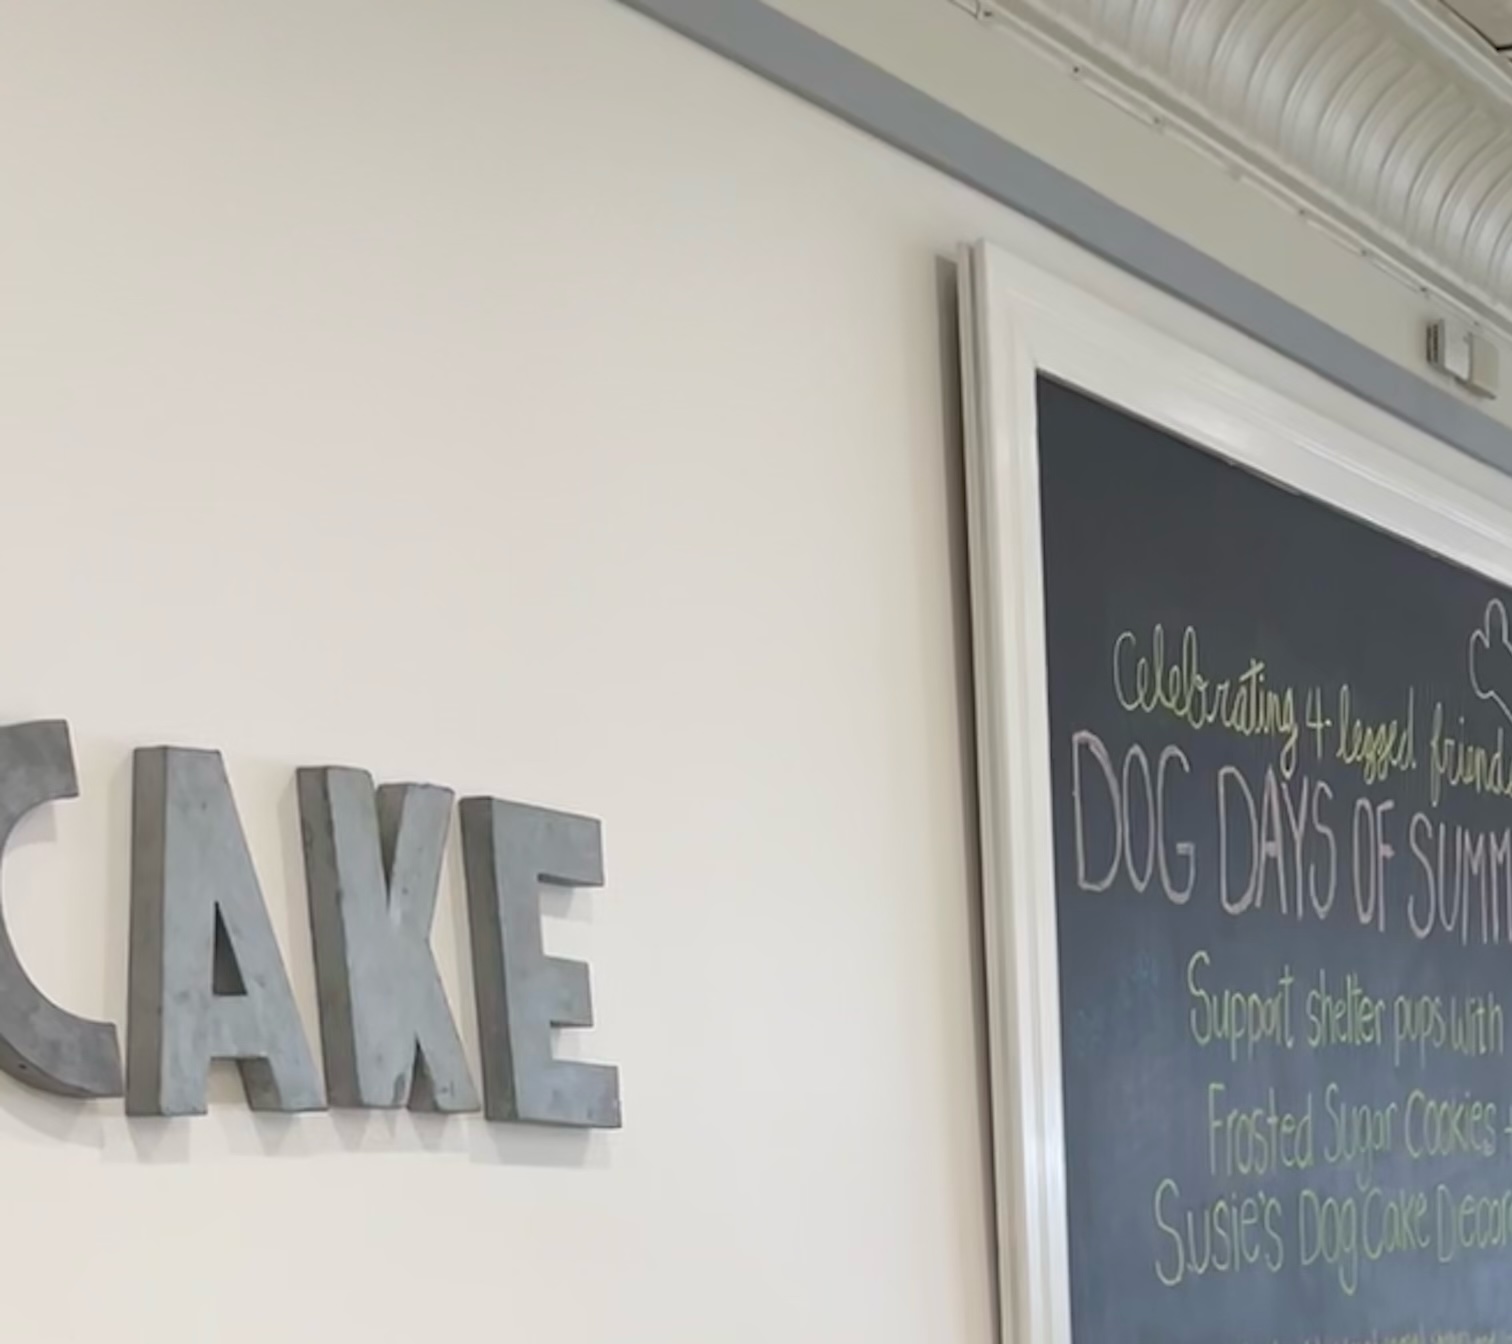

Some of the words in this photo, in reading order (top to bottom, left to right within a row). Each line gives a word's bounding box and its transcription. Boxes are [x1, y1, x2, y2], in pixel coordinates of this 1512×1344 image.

[1114, 622, 1299, 780] Celebrating
[1072, 730, 1196, 904] DOG
[1218, 765, 1337, 920] DAYS
[1353, 798, 1395, 932] OF
[0, 719, 622, 1128] CAKE
[1187, 950, 1294, 1062] Support
[1306, 968, 1385, 1047] shelter
[1394, 995, 1446, 1070] pups
[1452, 992, 1504, 1056] with
[1208, 1082, 1313, 1176] Frosted
[1324, 1082, 1397, 1192] Sugar
[1404, 1089, 1497, 1157] Cookies
[1155, 1178, 1284, 1287] Susie's
